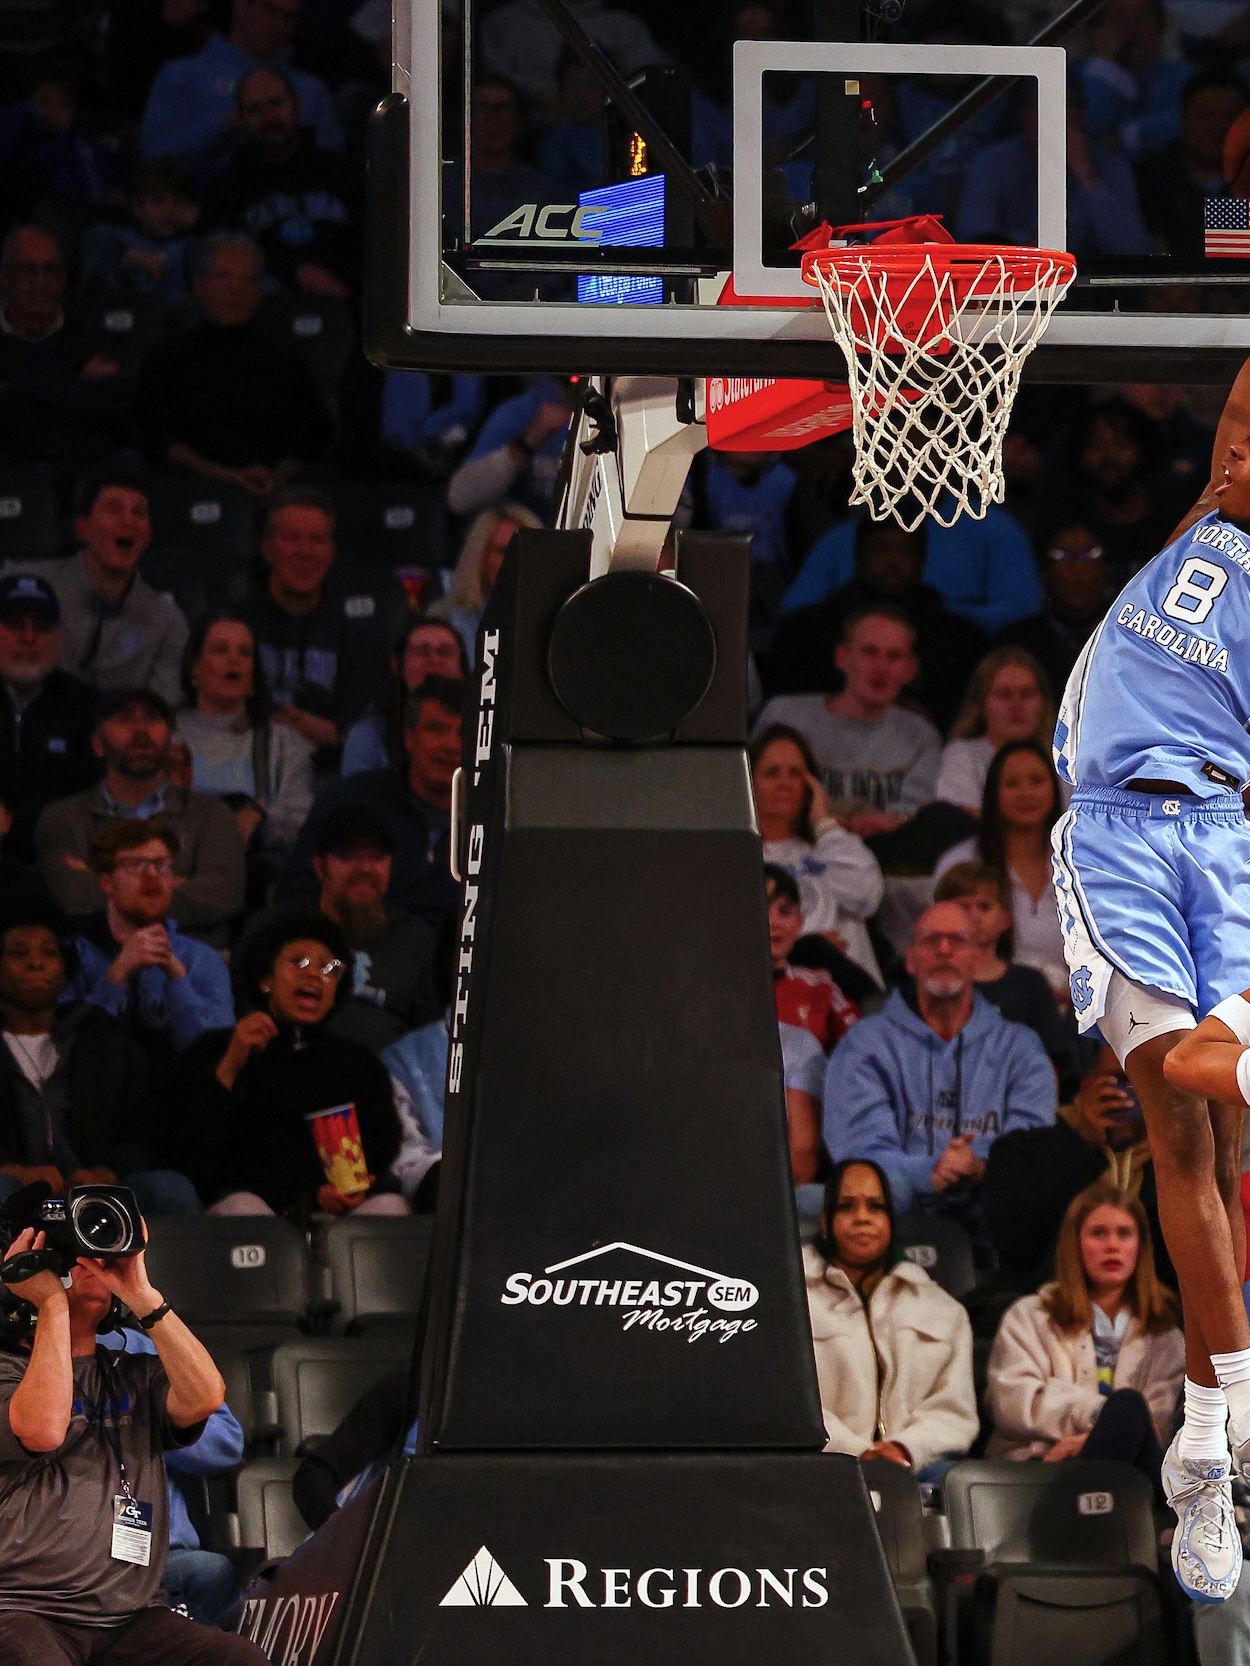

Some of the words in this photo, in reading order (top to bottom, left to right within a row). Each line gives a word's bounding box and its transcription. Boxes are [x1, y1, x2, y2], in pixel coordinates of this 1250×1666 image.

[484, 203, 609, 238] ACC
[1162, 556, 1229, 624] 8
[1117, 602, 1229, 672] CAROLINA
[449, 824, 484, 1093] STING
[237, 1248, 260, 1265] 10
[500, 1272, 706, 1306] SOUTHEAST
[713, 1286, 752, 1302] SEM
[622, 1308, 758, 1344] Mortgage
[125, 1505, 142, 1519] GT
[1086, 1494, 1107, 1511] 12
[542, 1558, 829, 1609] REGIONS
